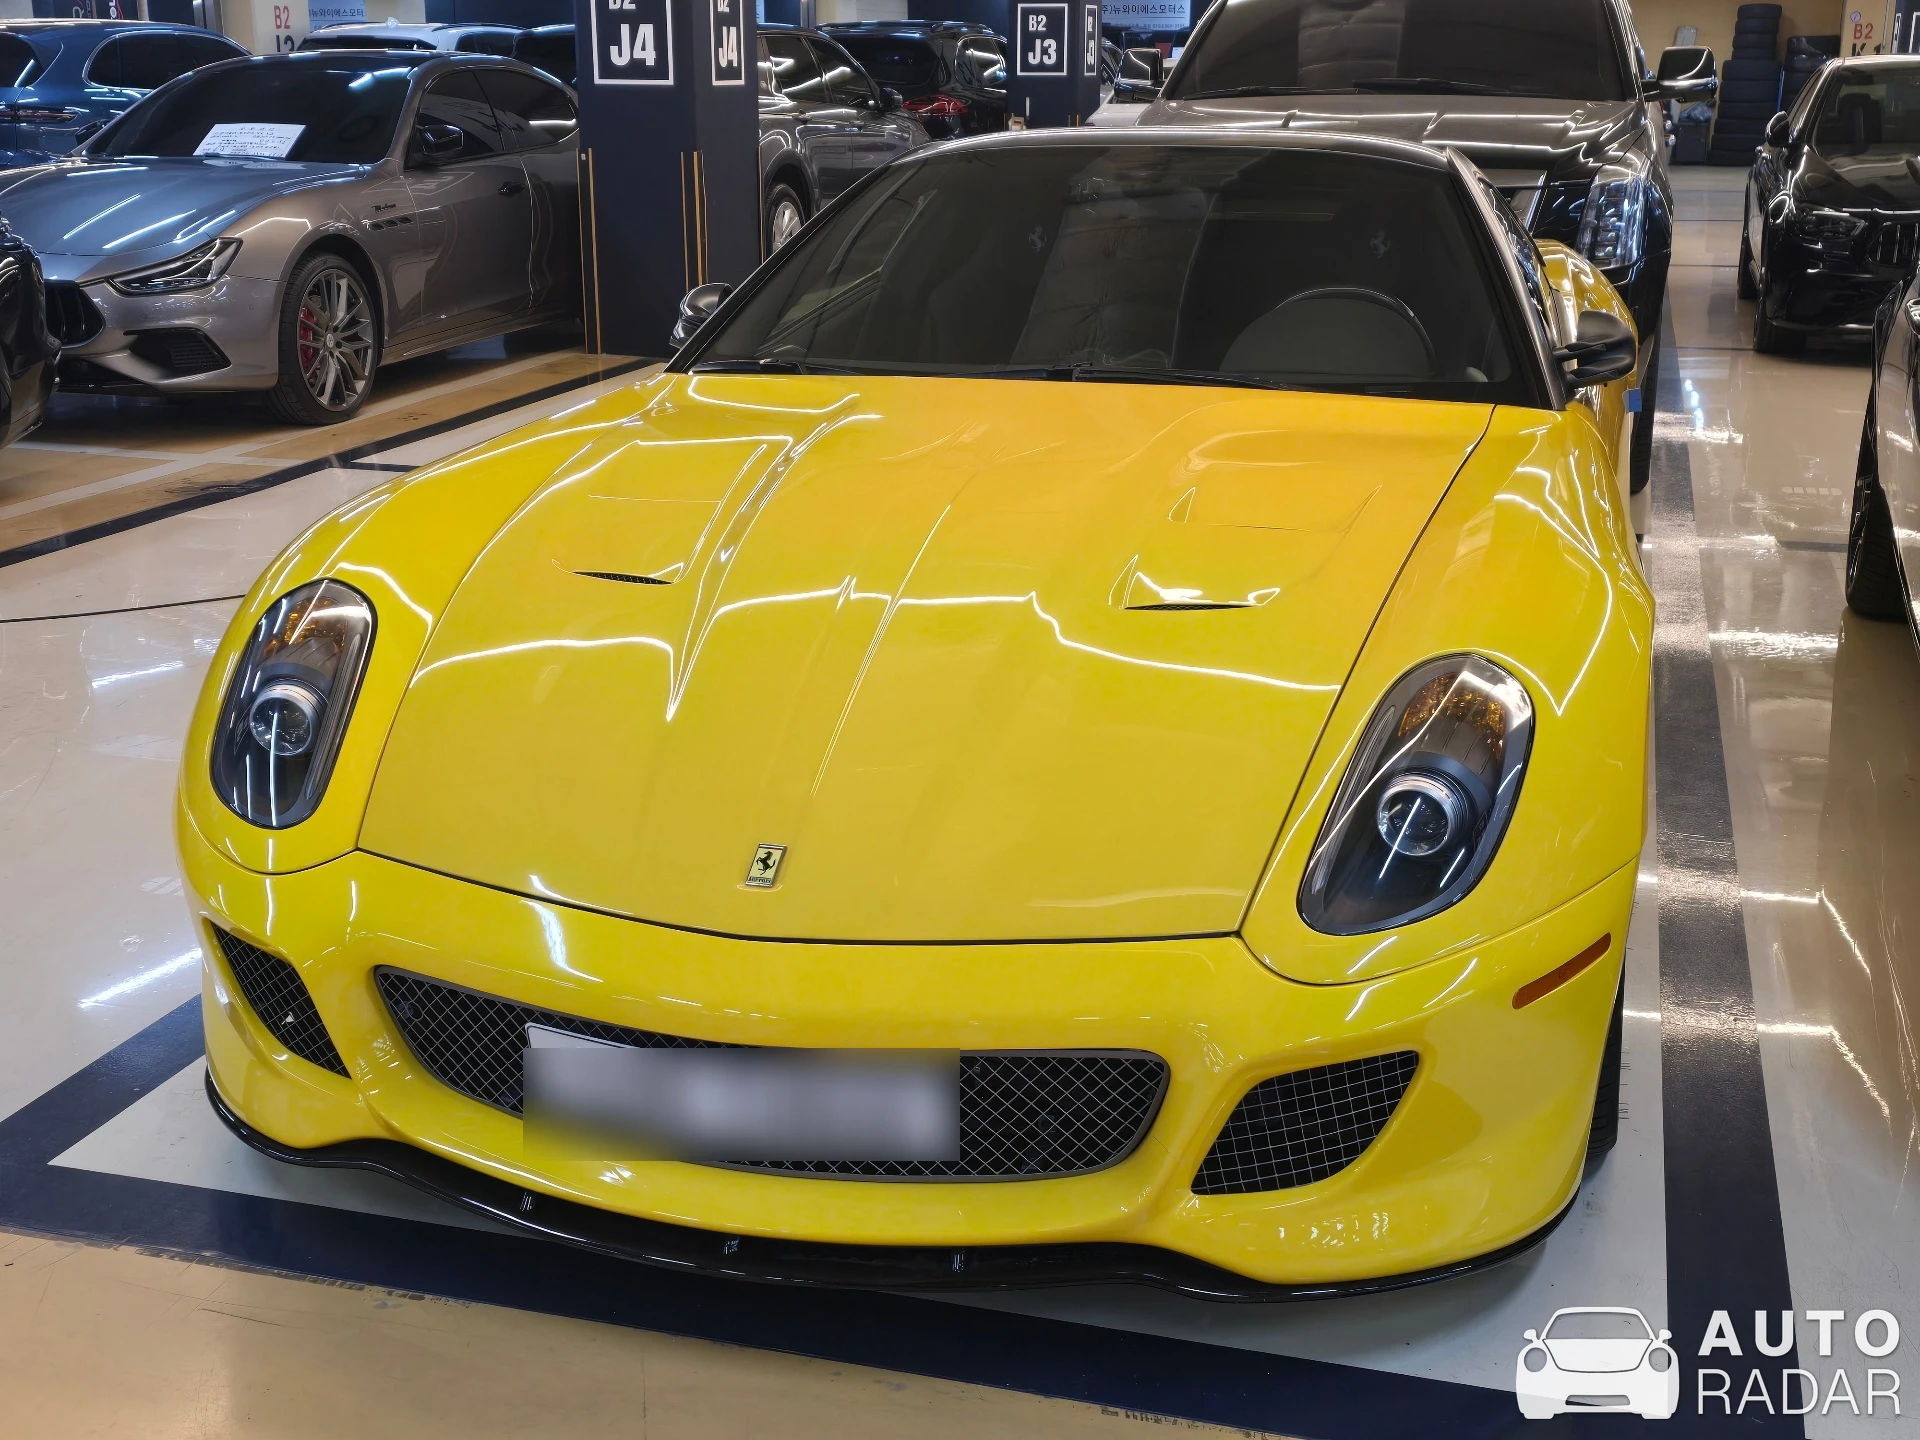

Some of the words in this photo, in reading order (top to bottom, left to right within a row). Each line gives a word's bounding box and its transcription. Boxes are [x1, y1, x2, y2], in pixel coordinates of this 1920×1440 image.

[274, 5, 291, 29] B2
[1029, 14, 1047, 31] B2
[1854, 22, 1874, 39] B2
[609, 23, 656, 66] J4
[718, 26, 738, 68] J4
[1028, 38, 1057, 65] J3
